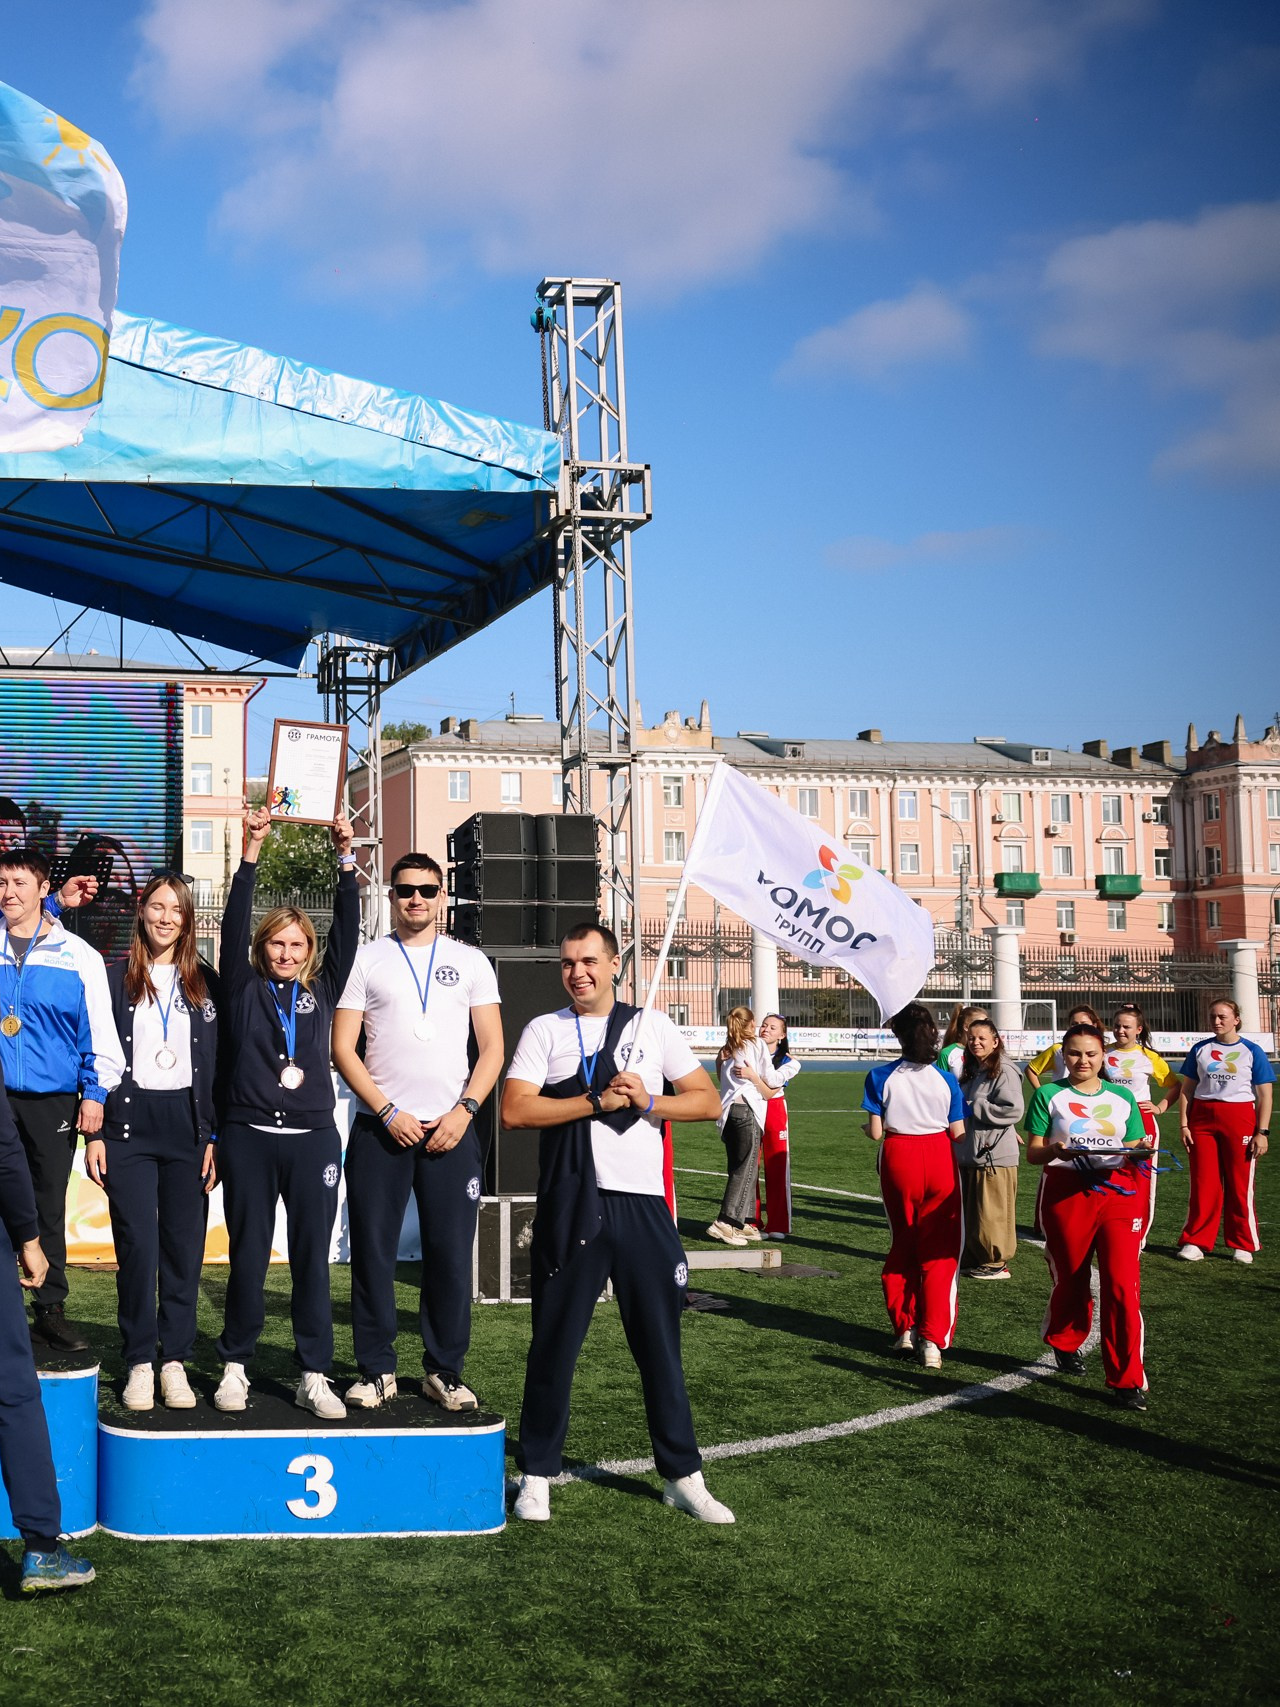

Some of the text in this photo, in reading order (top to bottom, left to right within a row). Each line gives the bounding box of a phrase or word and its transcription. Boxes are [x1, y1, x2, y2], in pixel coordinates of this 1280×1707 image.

[306, 733, 341, 743] ГРАМОТА
[774, 912, 826, 954] ГРУПП
[43, 957, 75, 968] МОЛОКО
[1207, 1073, 1237, 1081] КОМОС
[1070, 1136, 1113, 1146] КОМОС
[286, 1454, 338, 1520] 3
